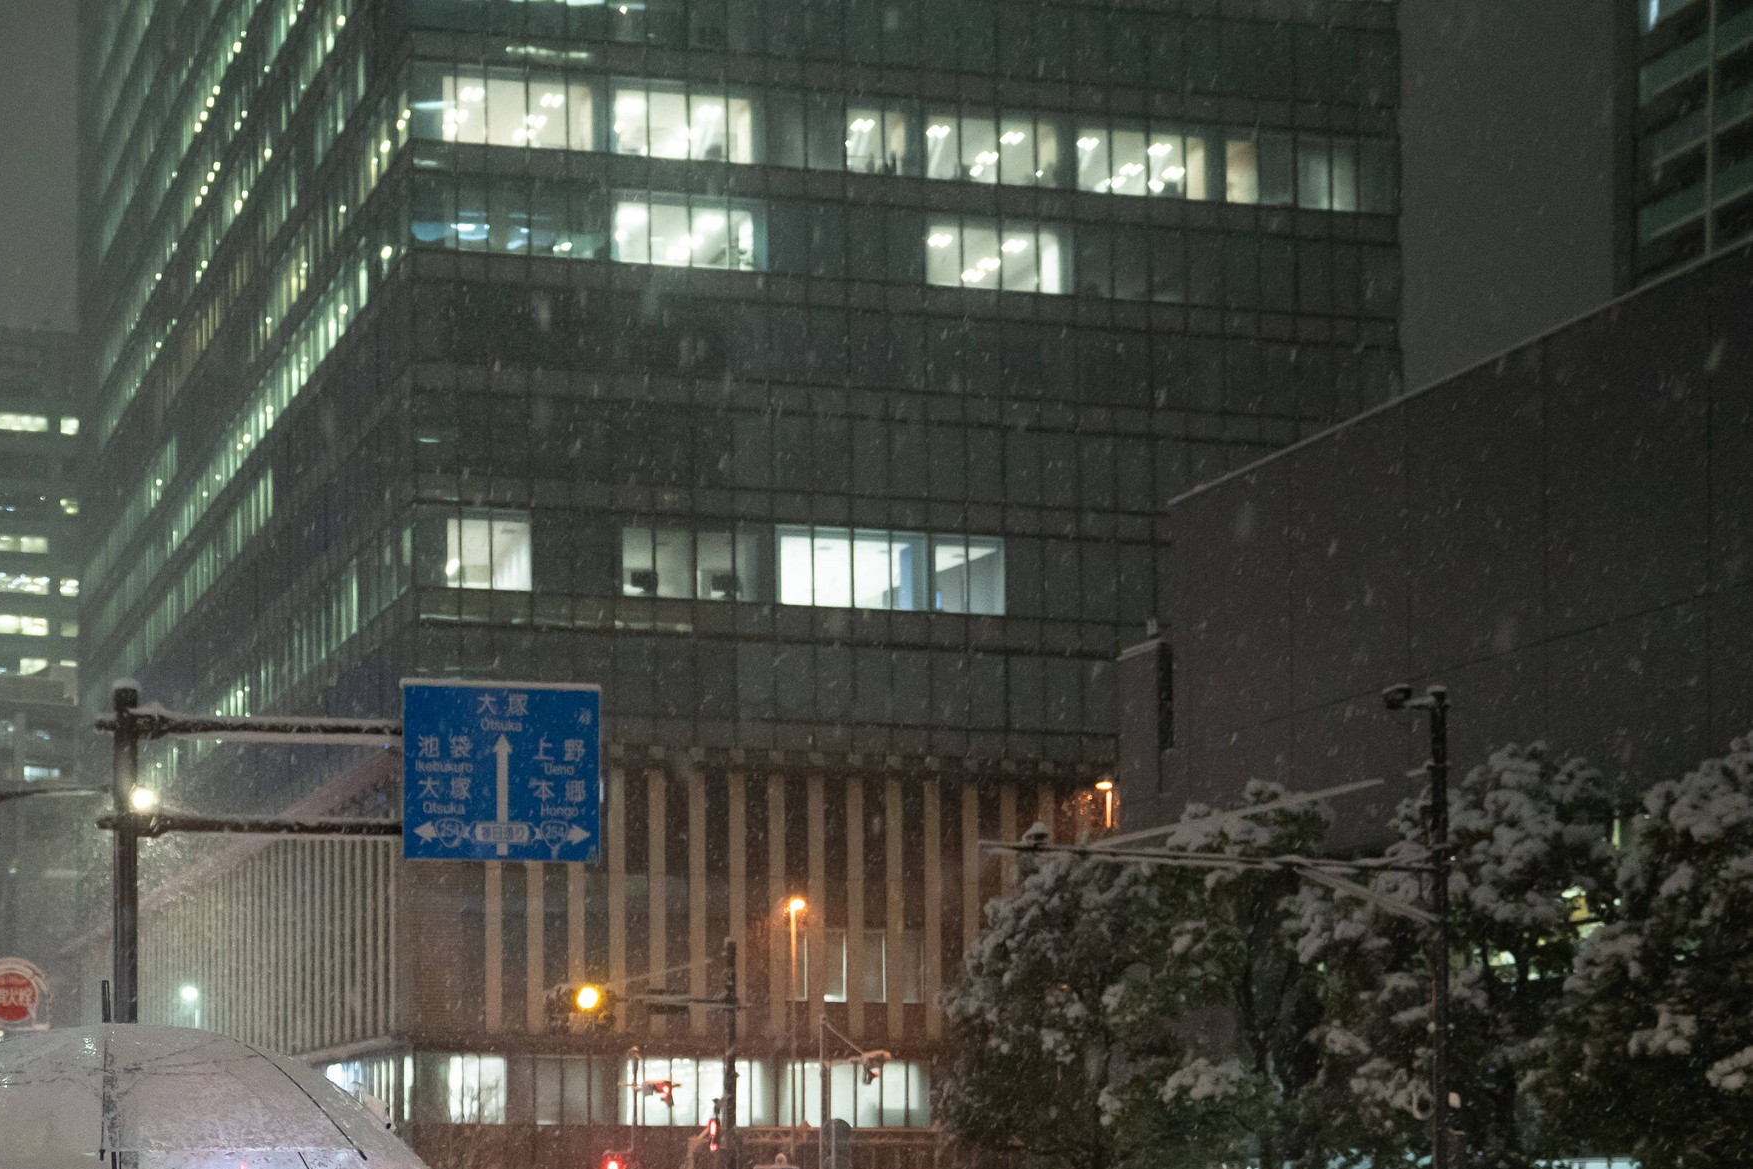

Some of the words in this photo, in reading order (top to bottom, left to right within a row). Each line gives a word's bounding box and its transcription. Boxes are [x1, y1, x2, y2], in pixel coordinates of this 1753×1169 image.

[477, 693, 529, 716] 大塚
[480, 719, 523, 732] Otsuka
[418, 735, 472, 758] 池袋
[533, 737, 586, 762] 上野
[415, 760, 474, 773] Ikebukuro
[418, 777, 472, 800] 大塚
[533, 780, 586, 802] 本郷
